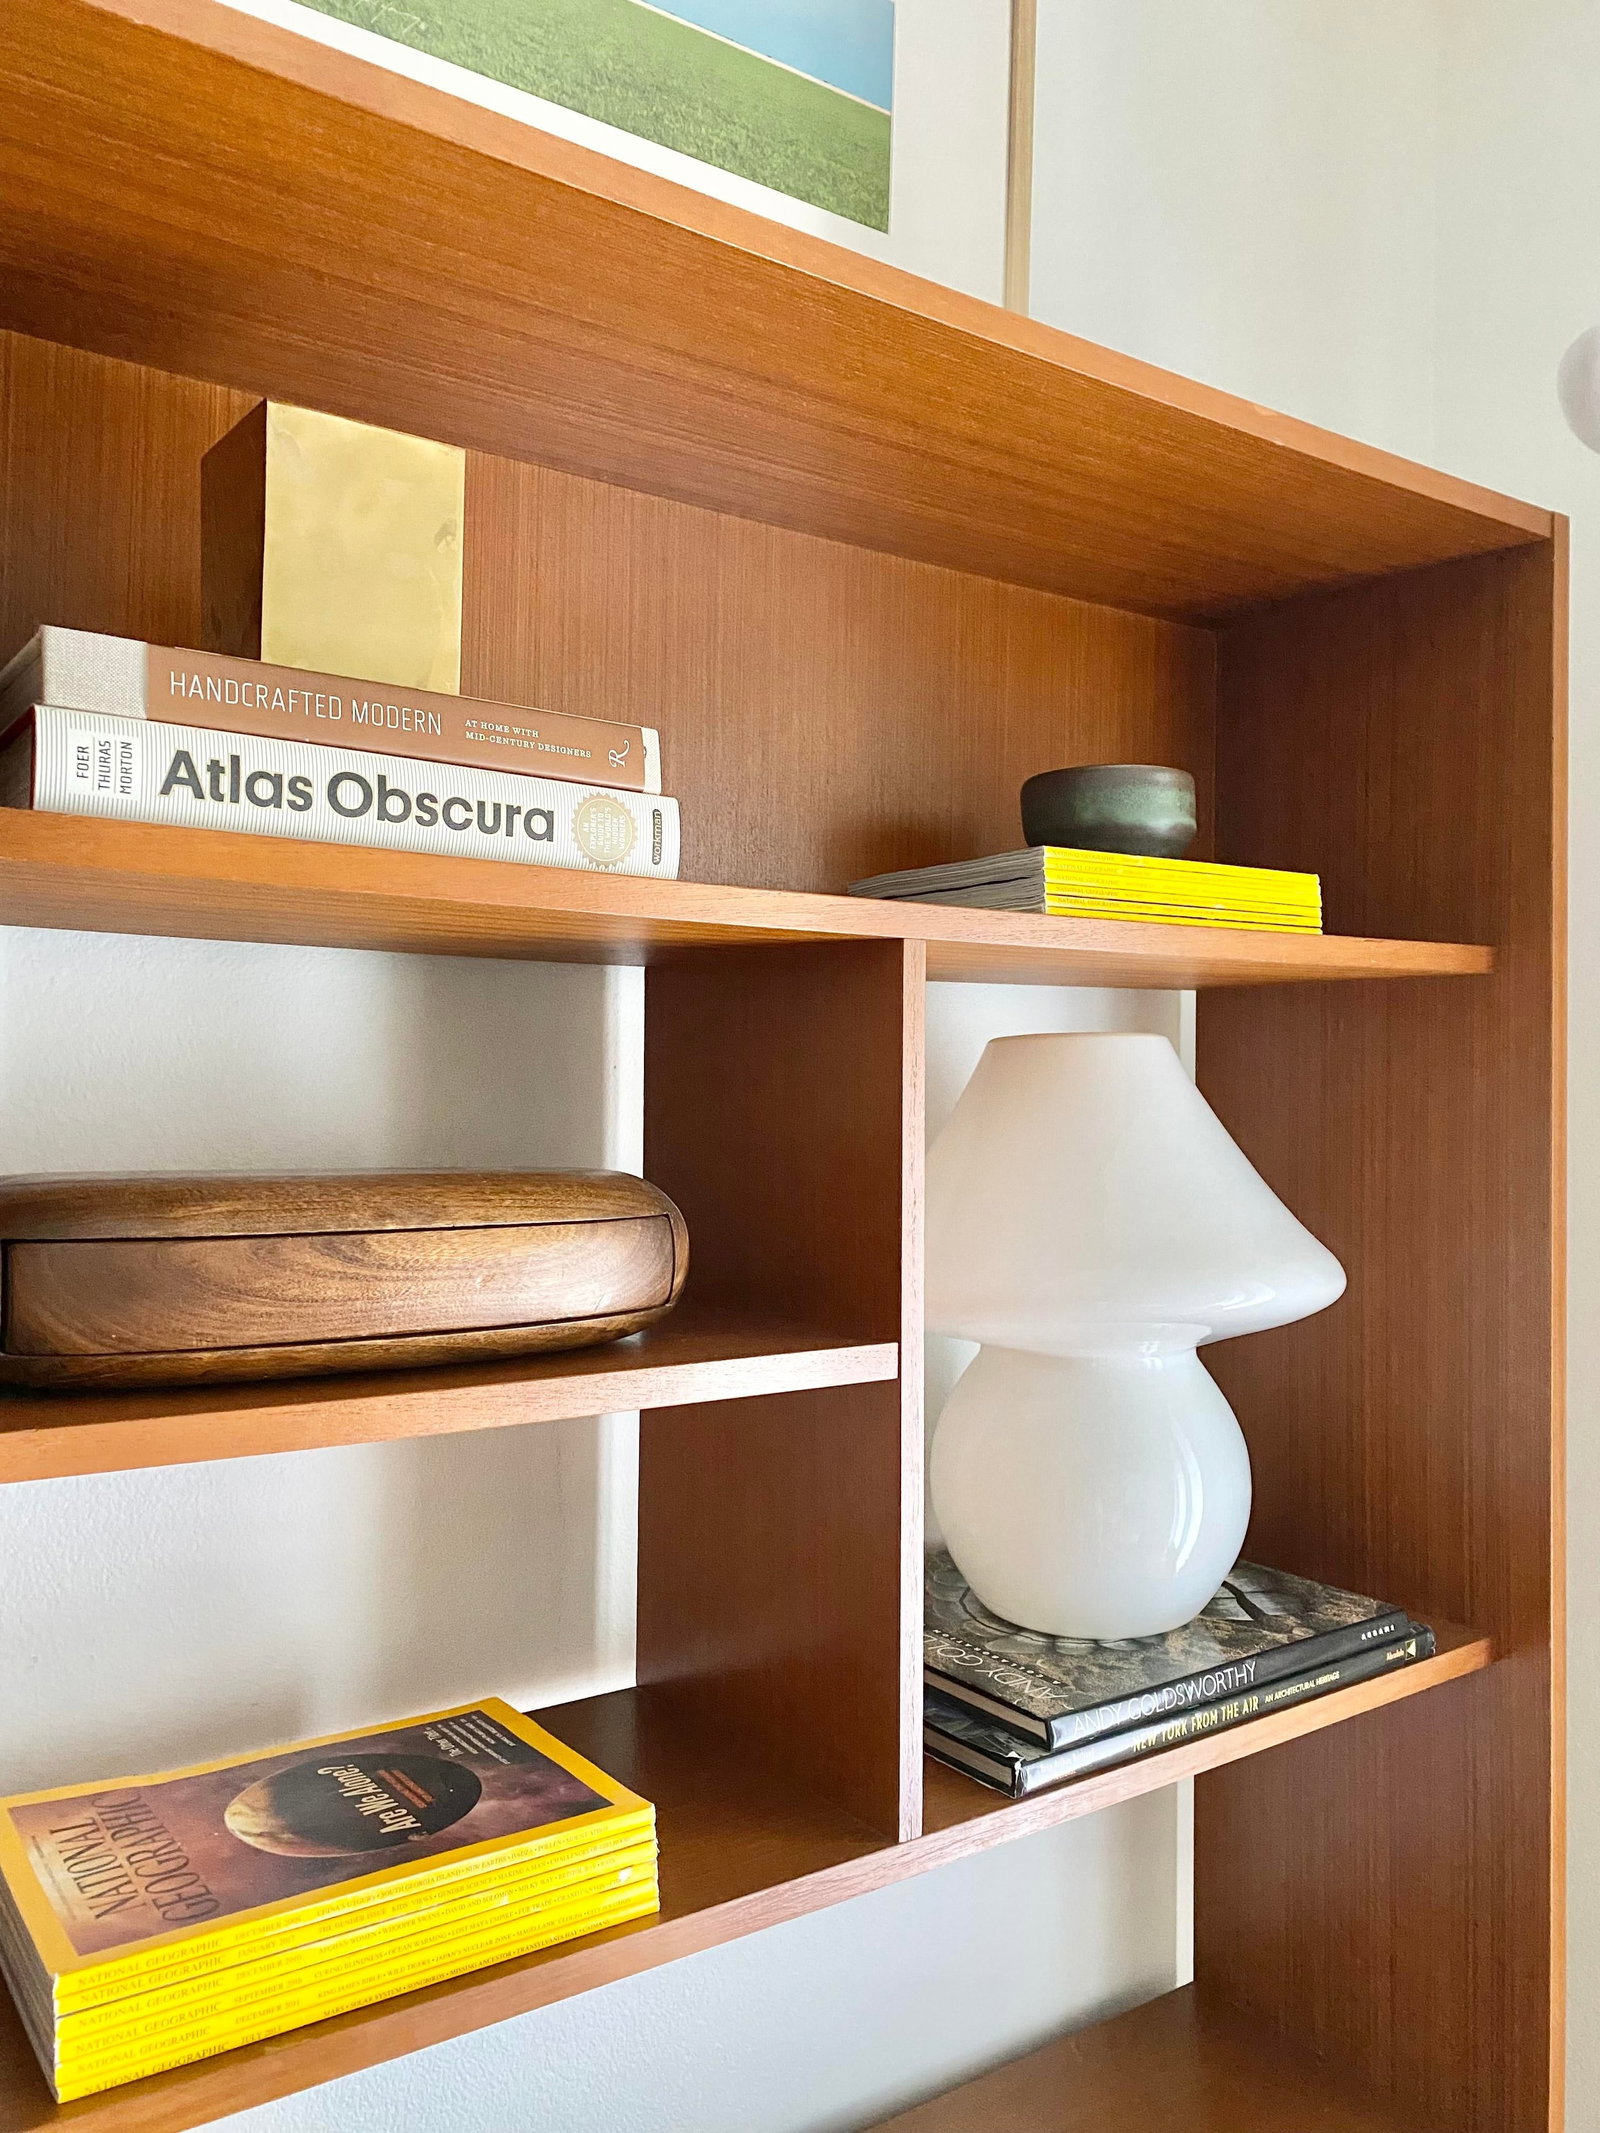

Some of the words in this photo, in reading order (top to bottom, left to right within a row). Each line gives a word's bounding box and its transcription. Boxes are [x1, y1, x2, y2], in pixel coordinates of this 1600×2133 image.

[170, 671, 342, 720] HANDCRAFTED
[352, 698, 442, 736] MODERN
[465, 719, 478, 729] AT
[481, 721, 510, 734] HOME
[512, 727, 539, 738] WITH
[77, 745, 89, 779] FOER
[98, 740, 112, 791] THURAS
[120, 741, 133, 794] MORTON
[465, 731, 536, 750] MID-CENTURY
[538, 743, 592, 759] DESIGNERS
[159, 749, 313, 812] Atlas
[327, 771, 555, 843] Obscura
[597, 812, 604, 822] TO
[583, 822, 590, 833] AN
[604, 807, 612, 839] WORLD'S
[611, 817, 619, 845] HIDDEN
[618, 815, 626, 849] WONDERS
[653, 811, 662, 864] workman
[975, 1668, 1068, 1699] ANDY
[1073, 1705, 1126, 1737] ANDY
[1127, 1660, 1257, 1720] GOLDSWORTHY
[1132, 1735, 1157, 1752] NEW
[1162, 1721, 1188, 1742] YORK
[1191, 1710, 1218, 1732] FROM
[1222, 1702, 1240, 1721] THE
[1242, 1695, 1259, 1714] AIR
[1264, 1694, 1274, 1703] AN
[1274, 1680, 1315, 1700] ARCHITECTURAL
[1316, 1671, 1340, 1686] HERITAGE
[316, 1763, 383, 1797] Alone?
[355, 1792, 399, 1816] We
[379, 1808, 422, 1834] Are
[49, 1818, 146, 1920] NATIONAL
[92, 1796, 221, 1922] GEOGRAPHIC
[78, 1961, 139, 1987] NATIONAL
[146, 1937, 221, 1967] GEOGRAPHIC
[80, 1978, 142, 2005] NATIONAL
[148, 1954, 223, 1985] GEOGRAPHIC
[76, 2027, 136, 2055] NATIONAL
[144, 2001, 219, 2033] GEOGRAPHIC
[78, 2002, 139, 2029] NATIONAL
[146, 1977, 222, 2008] GEOGRAPHIC
[77, 2048, 132, 2075] NATIONAL
[139, 2025, 209, 2055] GEOGRAPHIC
[152, 2041, 229, 2073] GEOGRAPHIC
